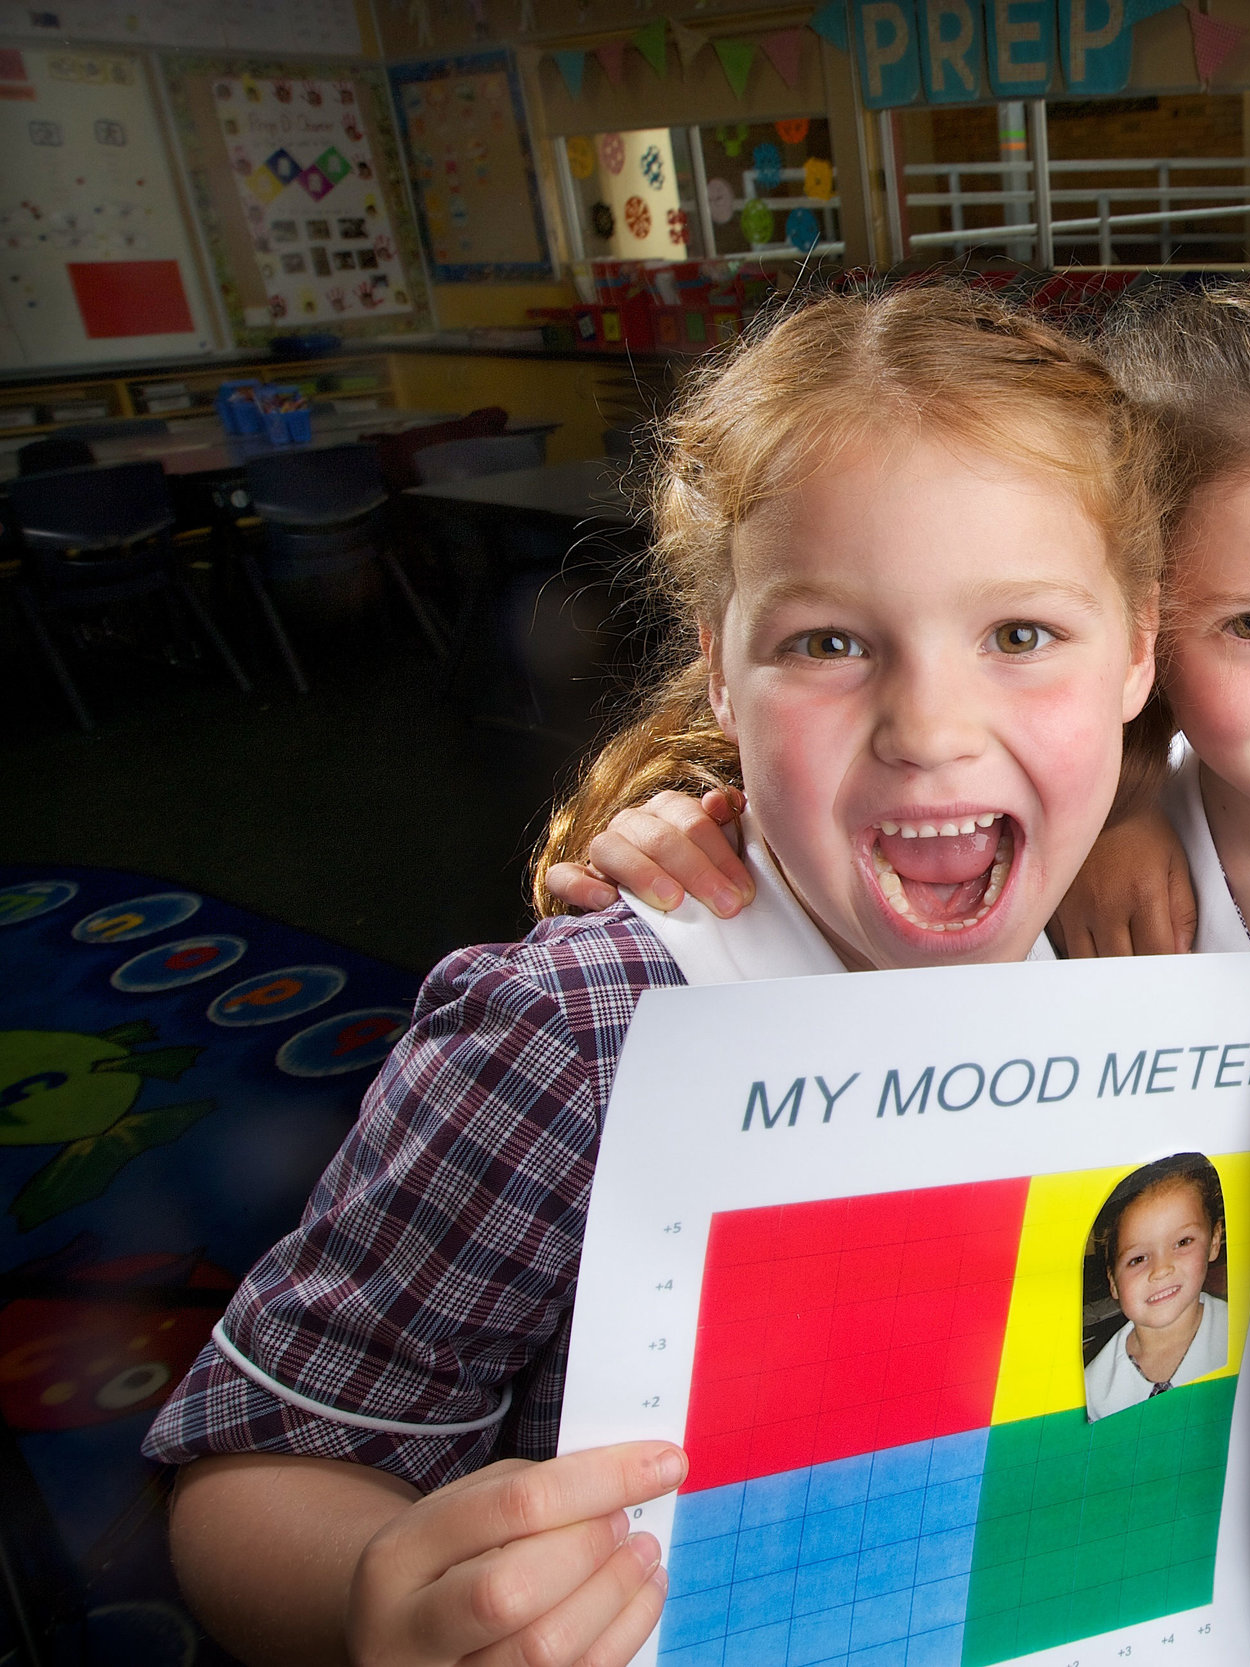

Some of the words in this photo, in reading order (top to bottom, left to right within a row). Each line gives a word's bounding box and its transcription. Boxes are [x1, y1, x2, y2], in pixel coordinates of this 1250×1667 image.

[860, 0, 1125, 98] PREP
[741, 1073, 861, 1131] MY
[876, 1056, 1080, 1118] MOOD
[663, 1222, 683, 1235] +5
[655, 1279, 674, 1292] +4
[648, 1338, 667, 1351] +3
[641, 1396, 661, 1408] +2
[1197, 1623, 1212, 1635] +5
[1161, 1633, 1175, 1646] +4
[1117, 1645, 1132, 1657] +3
